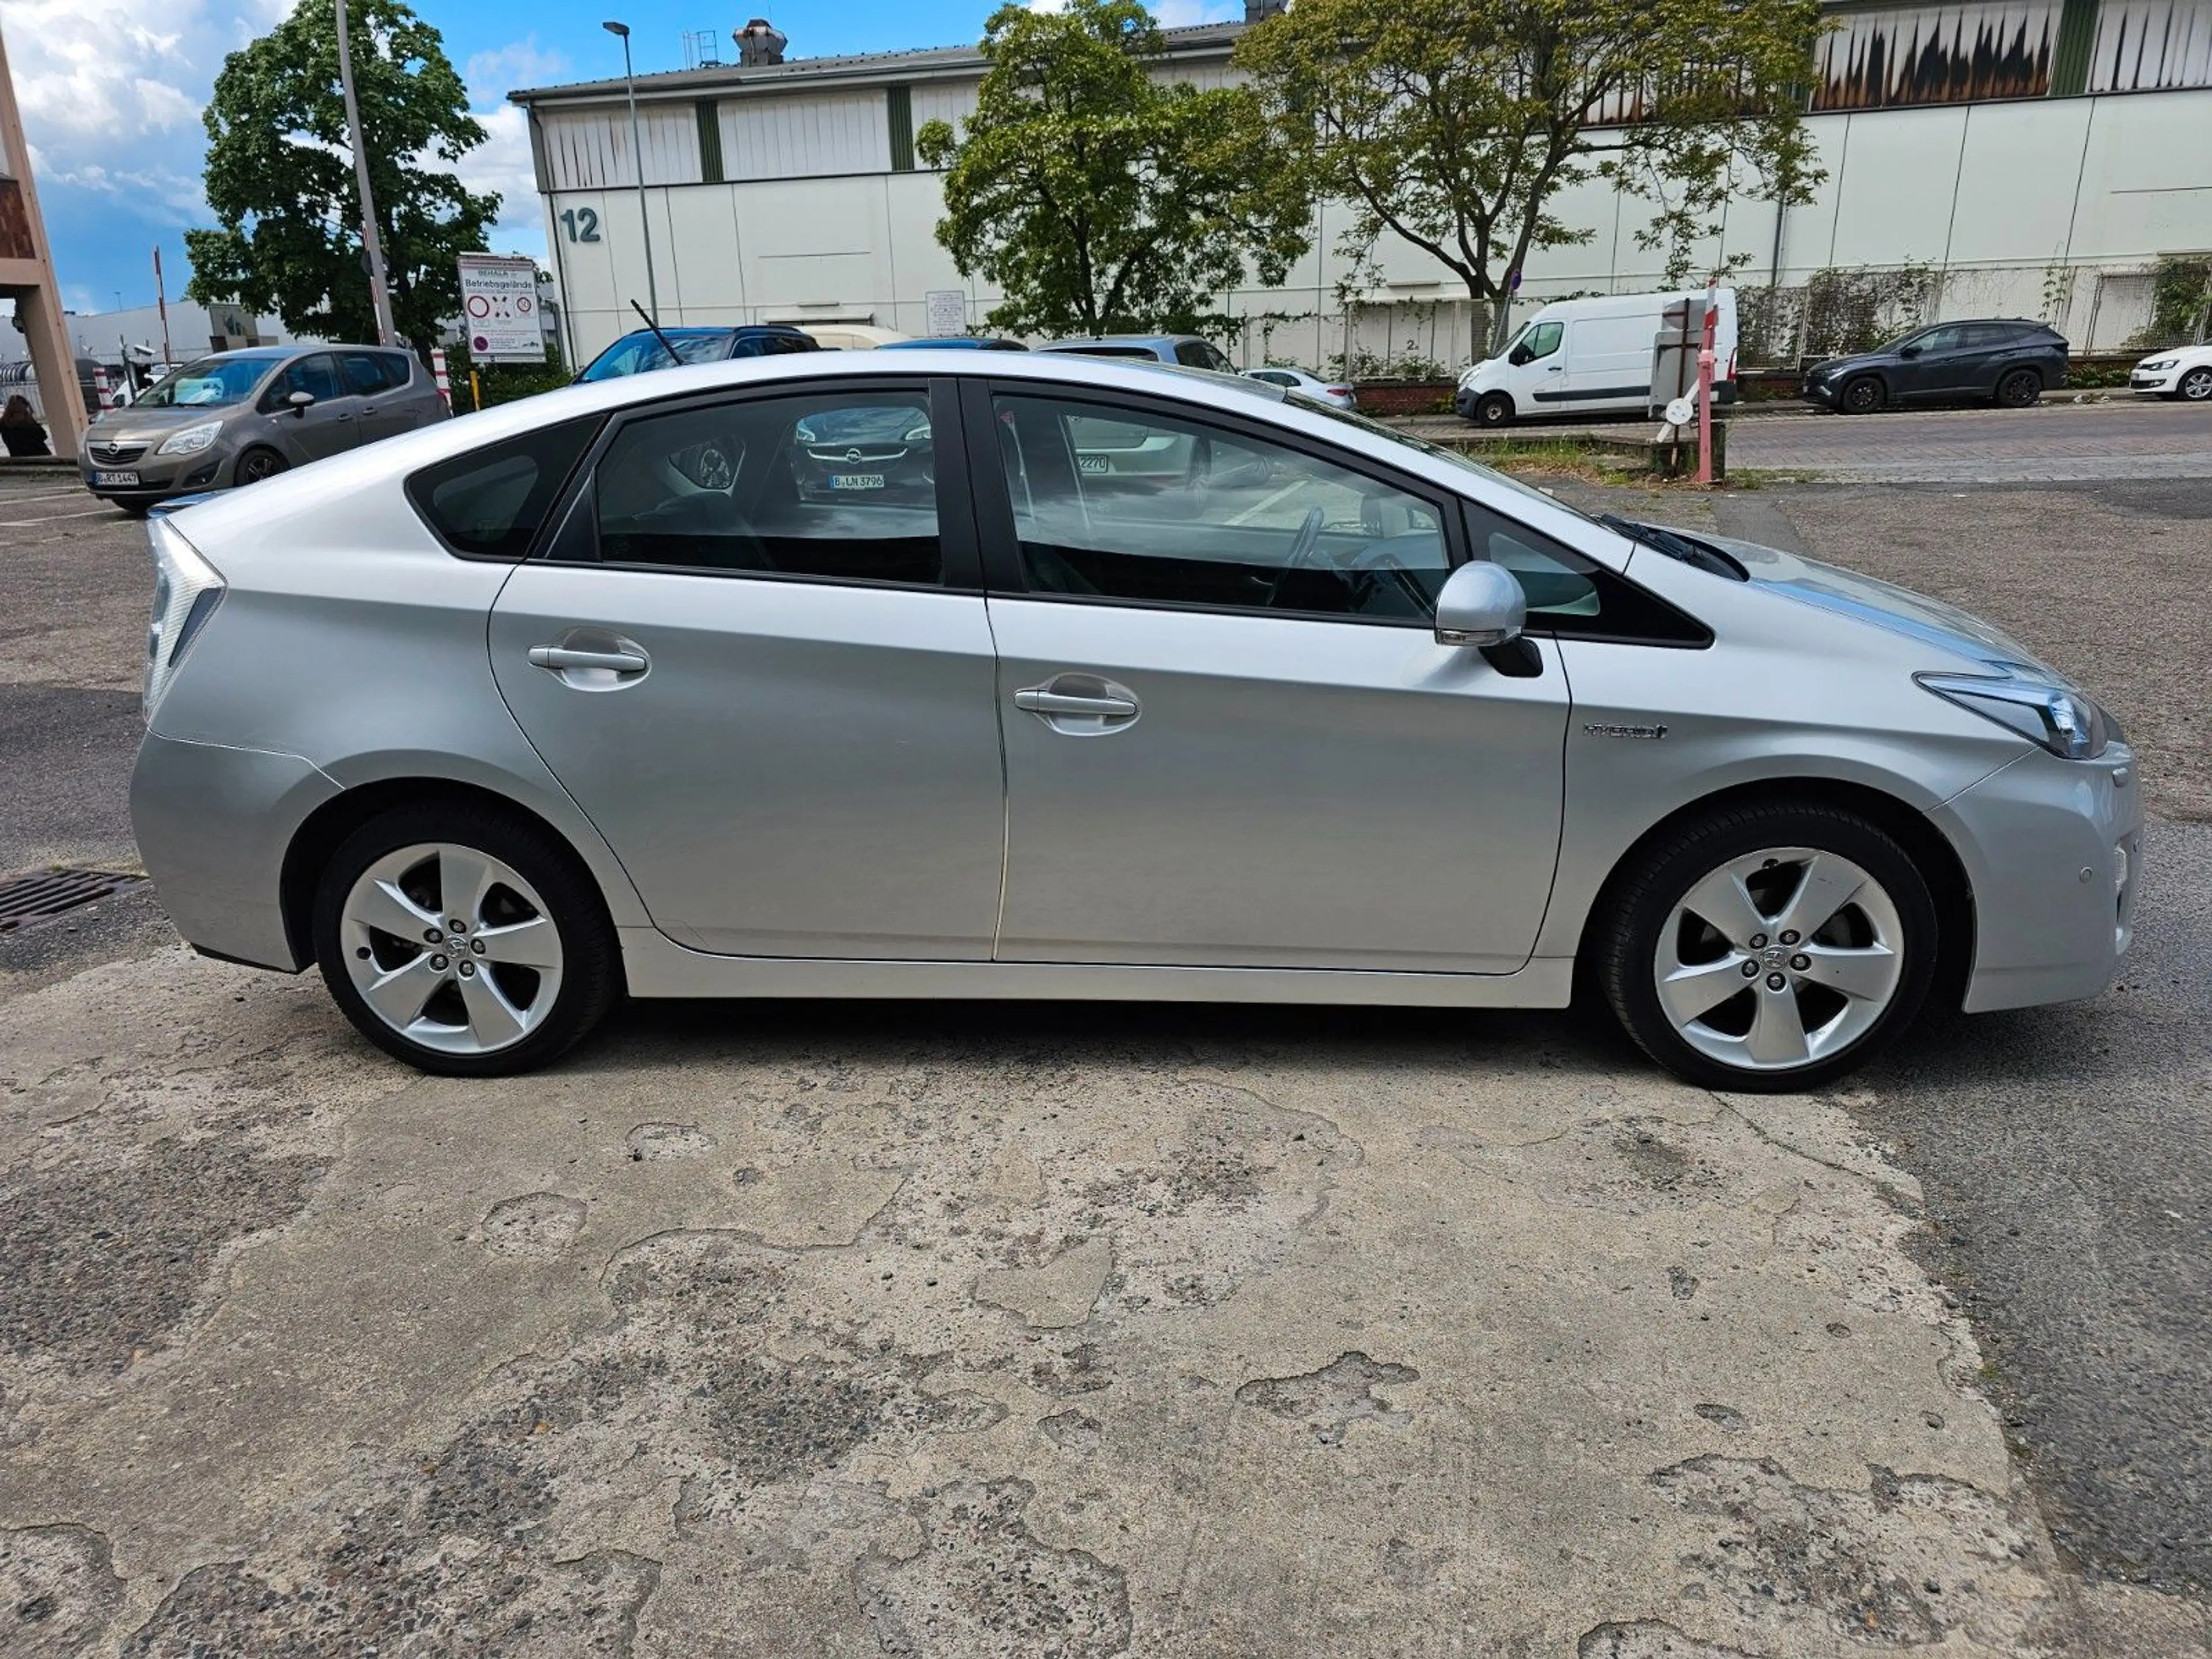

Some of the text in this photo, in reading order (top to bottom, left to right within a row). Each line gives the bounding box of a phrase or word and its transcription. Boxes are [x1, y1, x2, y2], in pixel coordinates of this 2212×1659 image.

[559, 207, 600, 243] 12
[465, 278, 532, 289] Betriebsgelände
[859, 476, 883, 486] 3796
